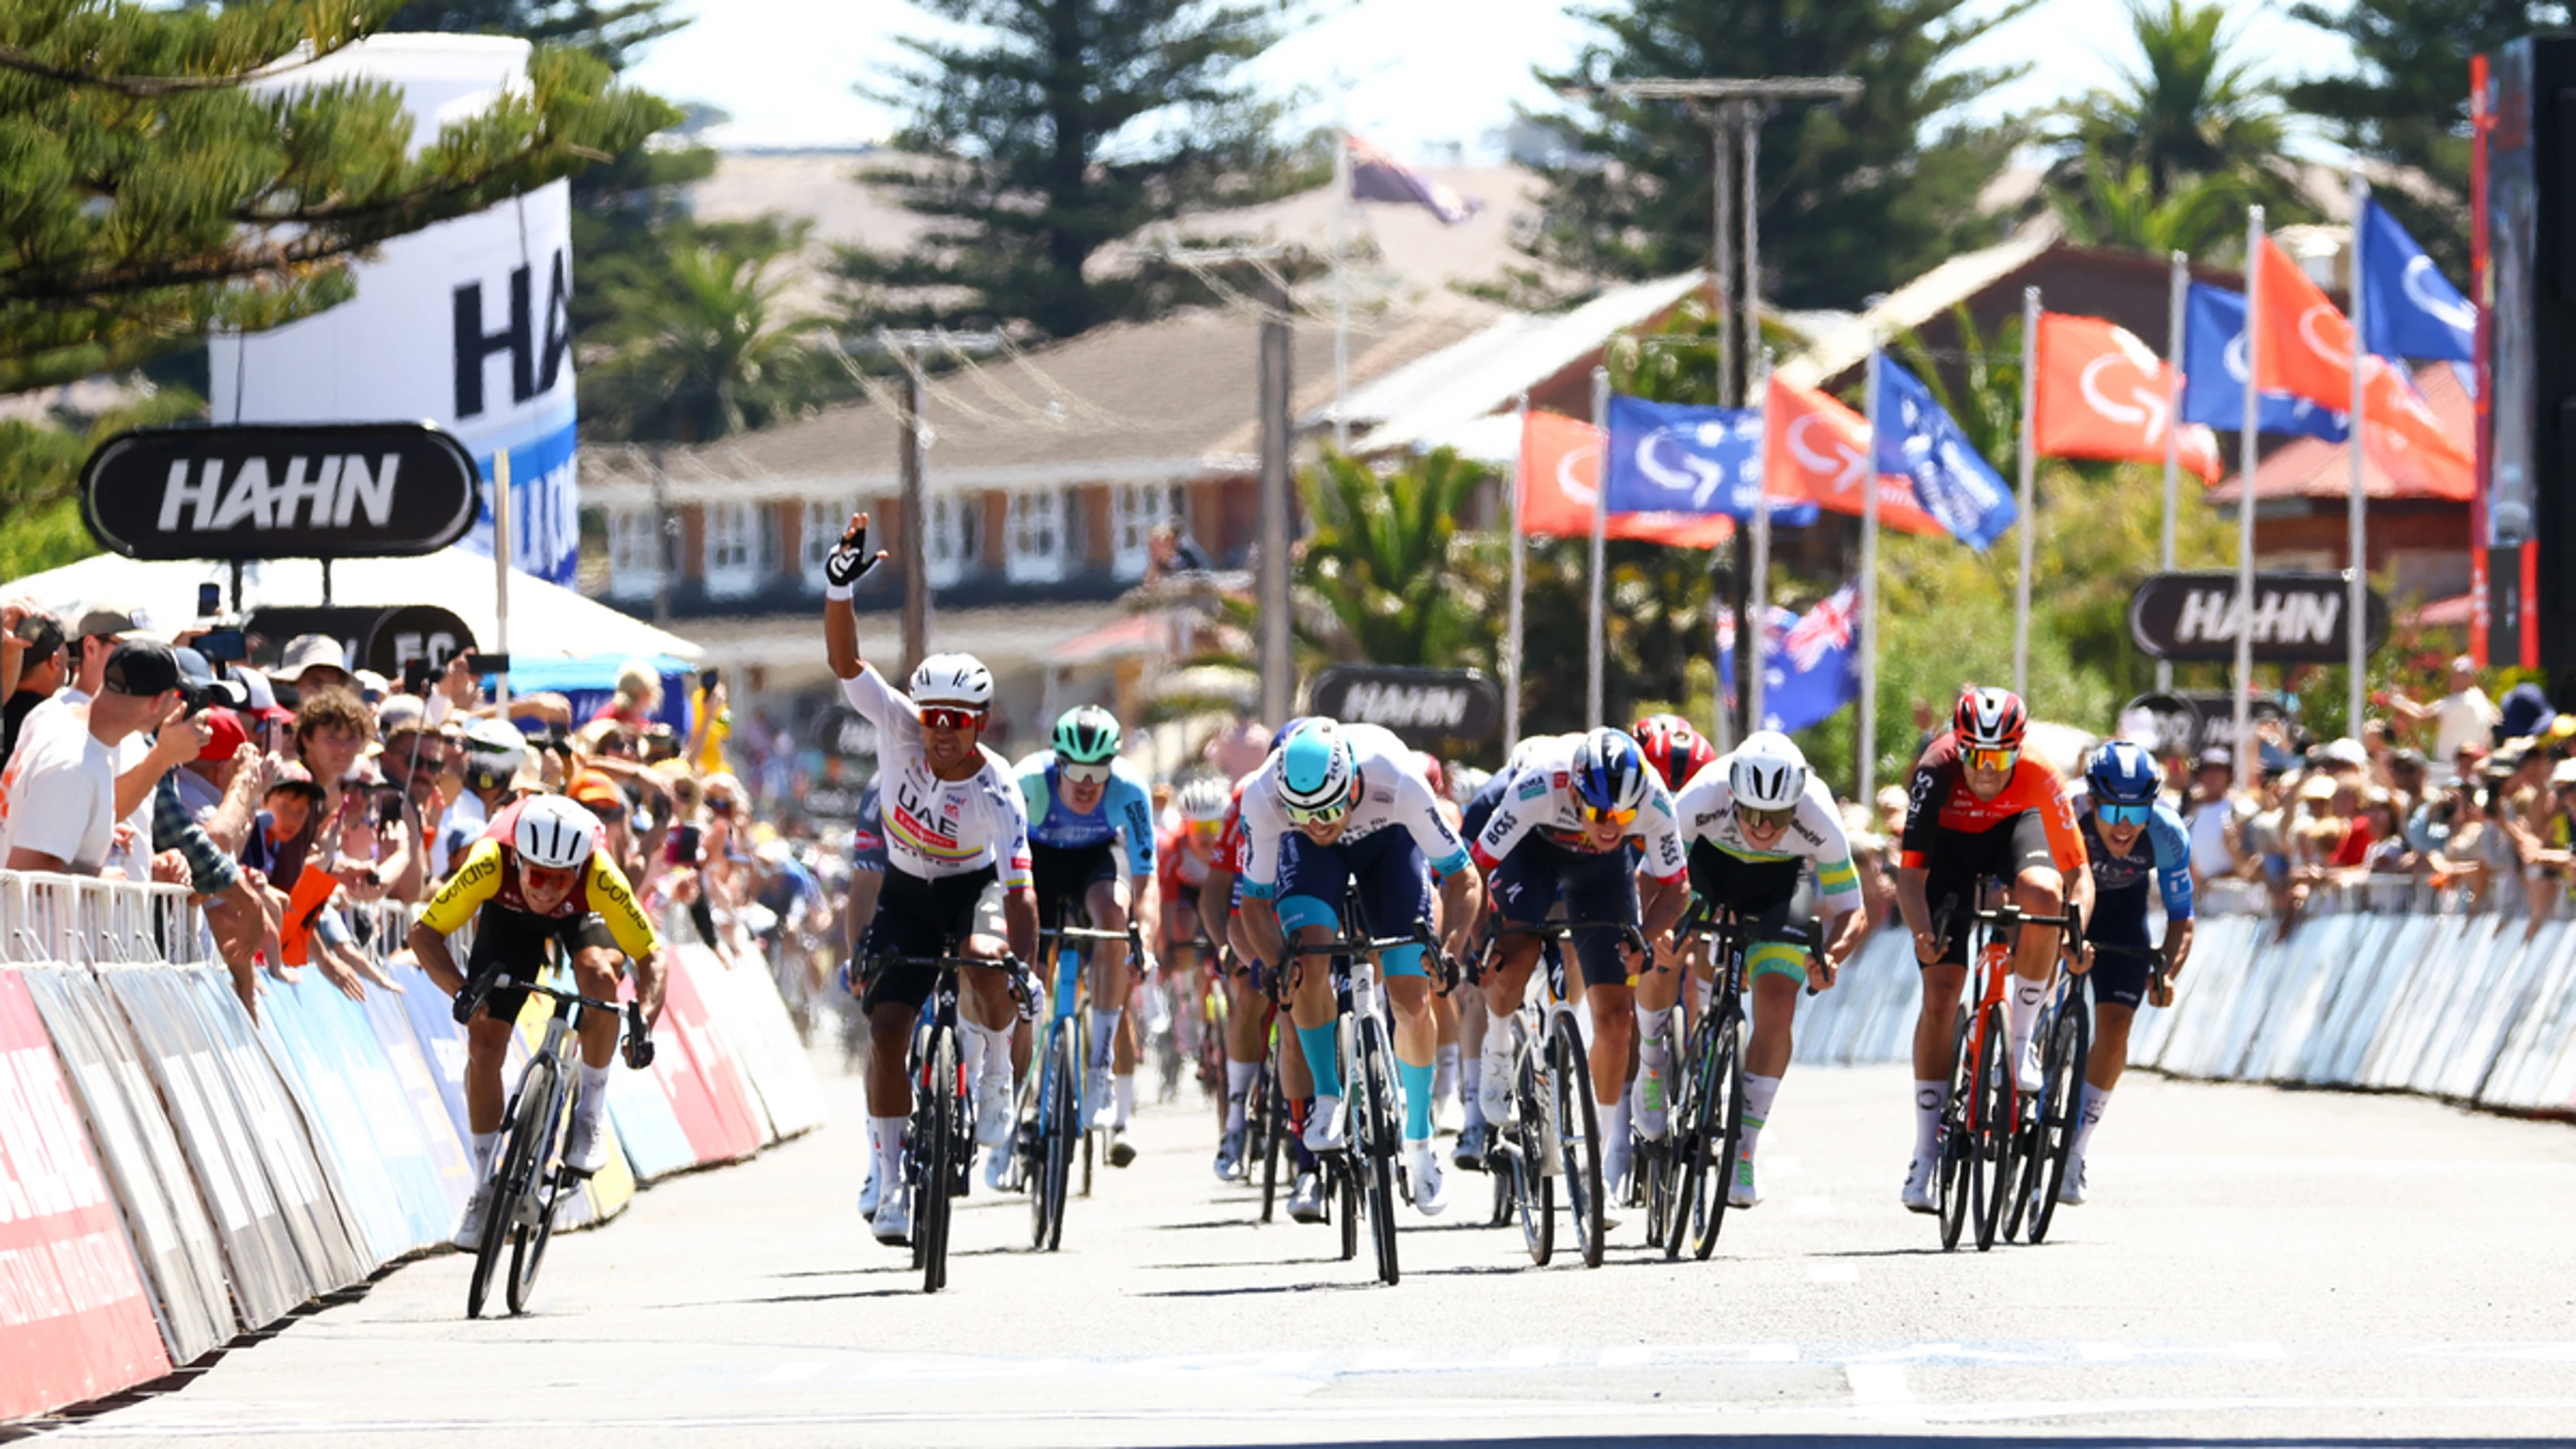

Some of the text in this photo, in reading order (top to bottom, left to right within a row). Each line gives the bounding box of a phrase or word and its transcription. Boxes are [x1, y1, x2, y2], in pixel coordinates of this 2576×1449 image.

[158, 453, 400, 531] HAHN
[1342, 680, 1470, 727] HAHN
[898, 783, 959, 840] UAE
